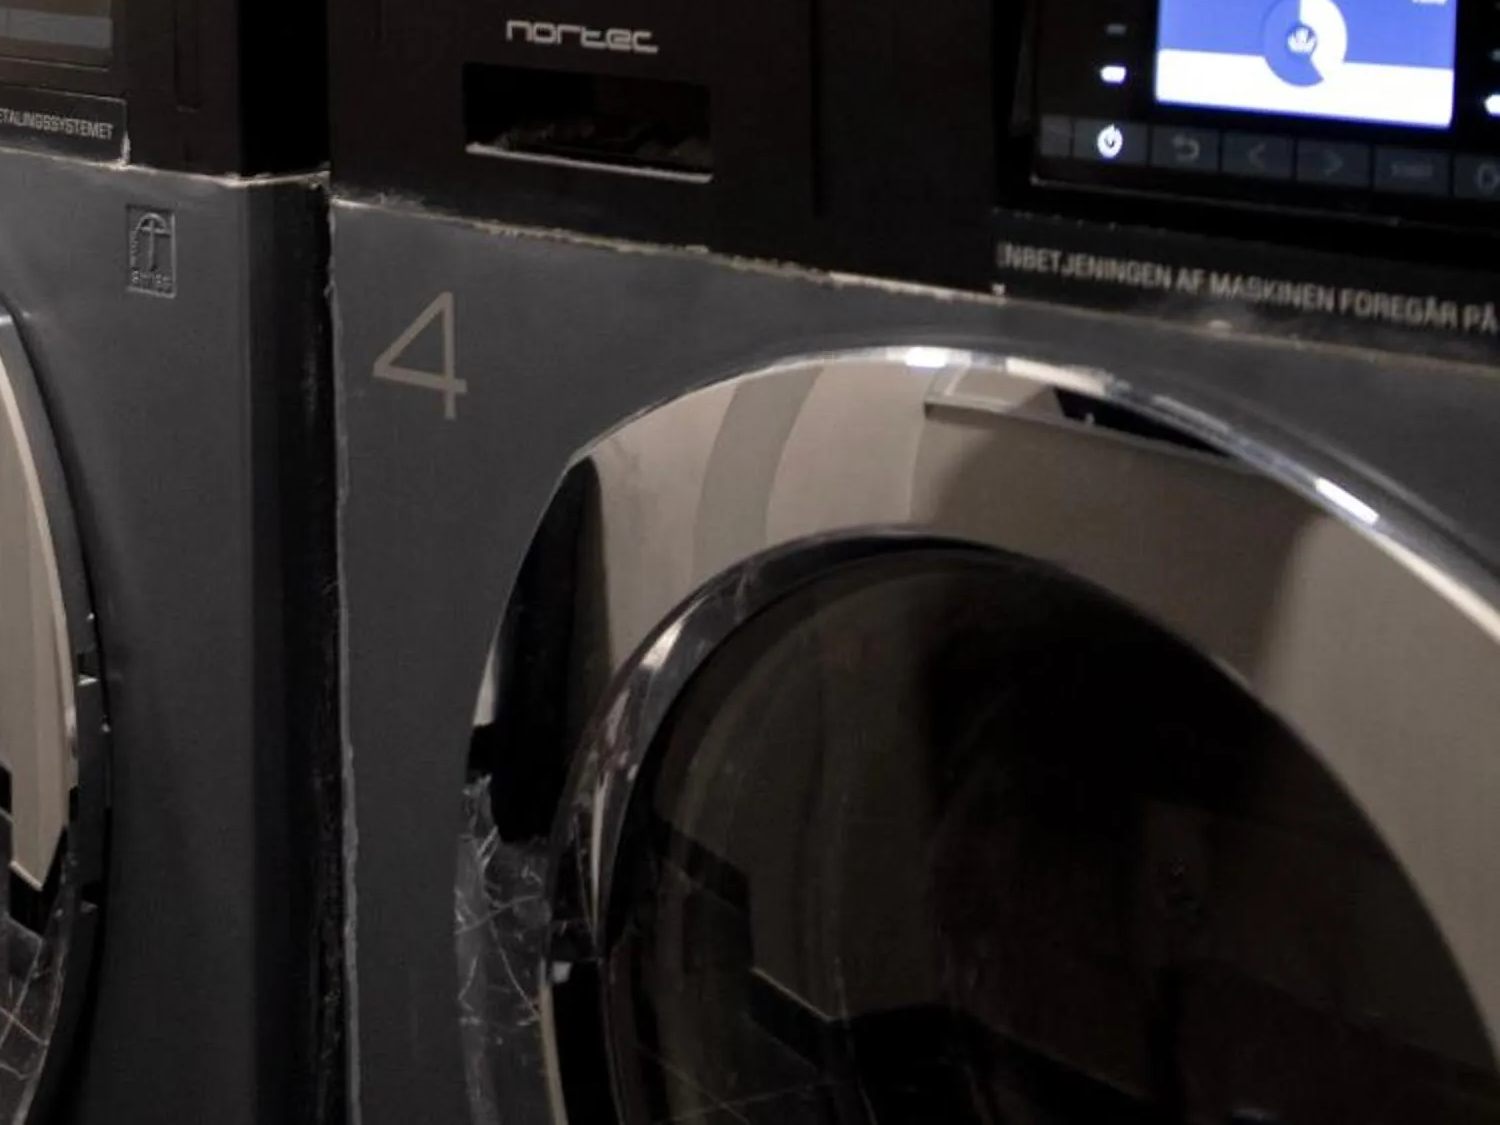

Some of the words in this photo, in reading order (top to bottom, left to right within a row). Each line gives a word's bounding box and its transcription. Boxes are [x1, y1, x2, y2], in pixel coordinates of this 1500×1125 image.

[506, 19, 660, 55] nortec
[1176, 267, 1206, 295] AF
[1210, 272, 1336, 313] MASKINEN
[1339, 287, 1459, 329] FOREGÅR
[1463, 301, 1499, 335] PÅ
[372, 291, 468, 421] 4
